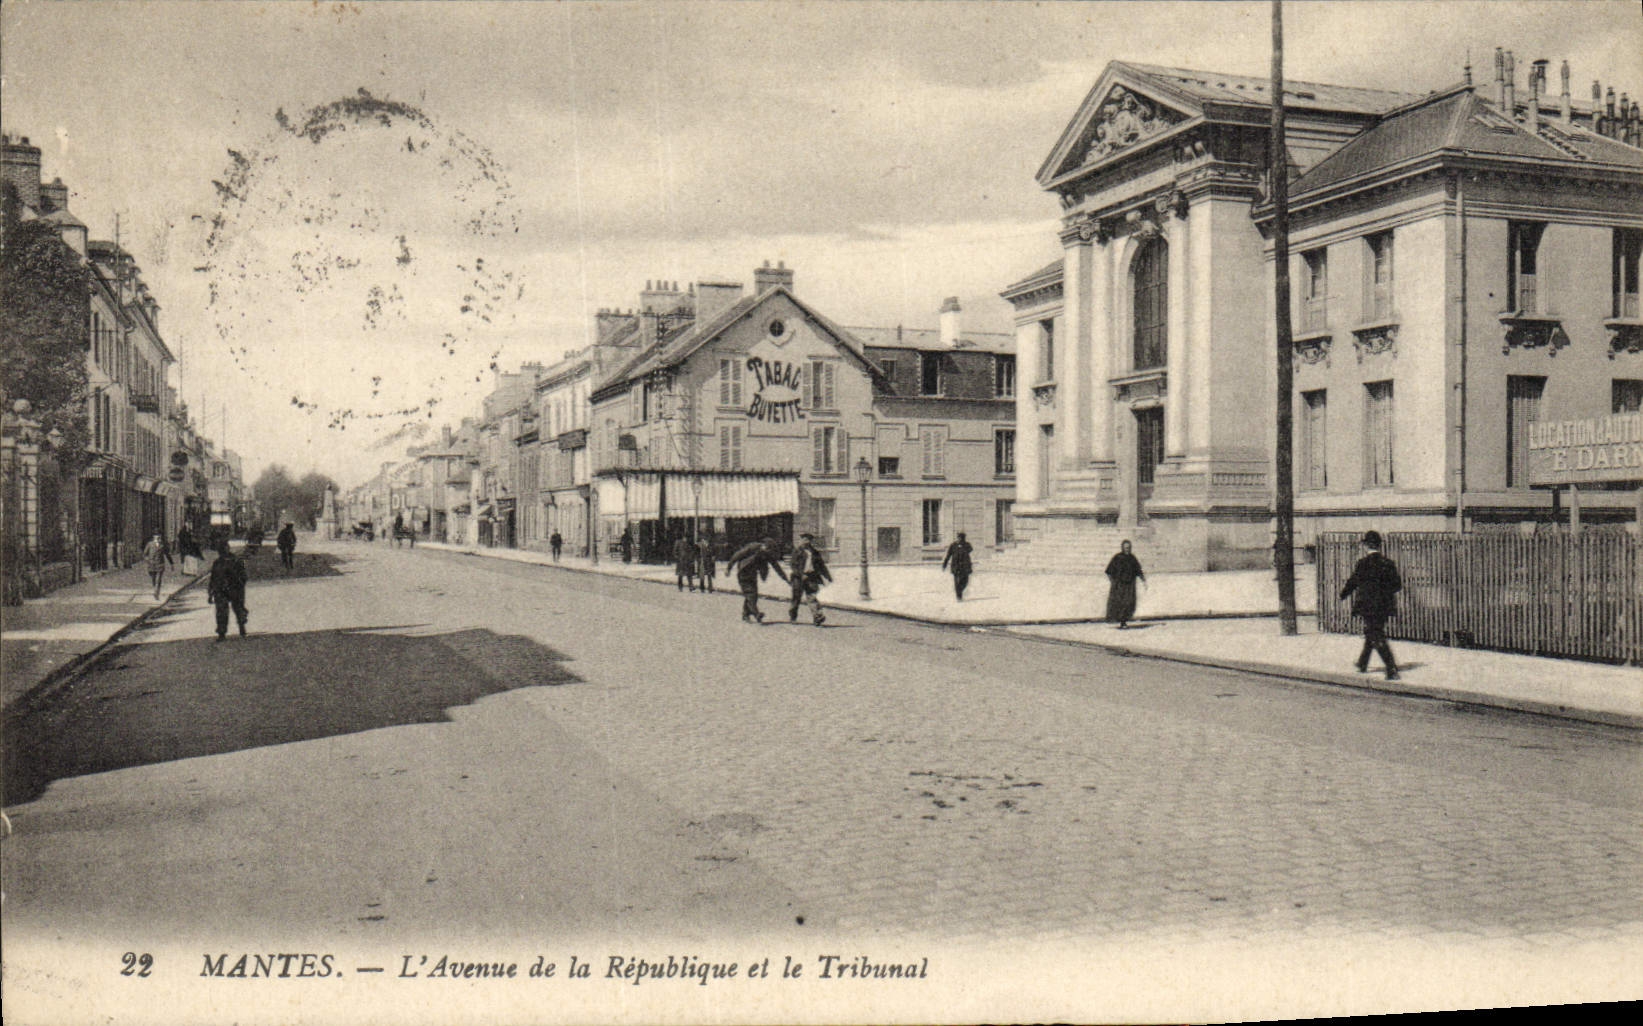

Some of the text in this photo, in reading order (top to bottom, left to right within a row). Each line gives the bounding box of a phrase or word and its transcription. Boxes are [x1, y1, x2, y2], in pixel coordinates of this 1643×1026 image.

[746, 356, 802, 392] TABAC
[746, 393, 806, 423] BUVETTE
[1529, 414, 1643, 449] LOCATION d'AUTO
